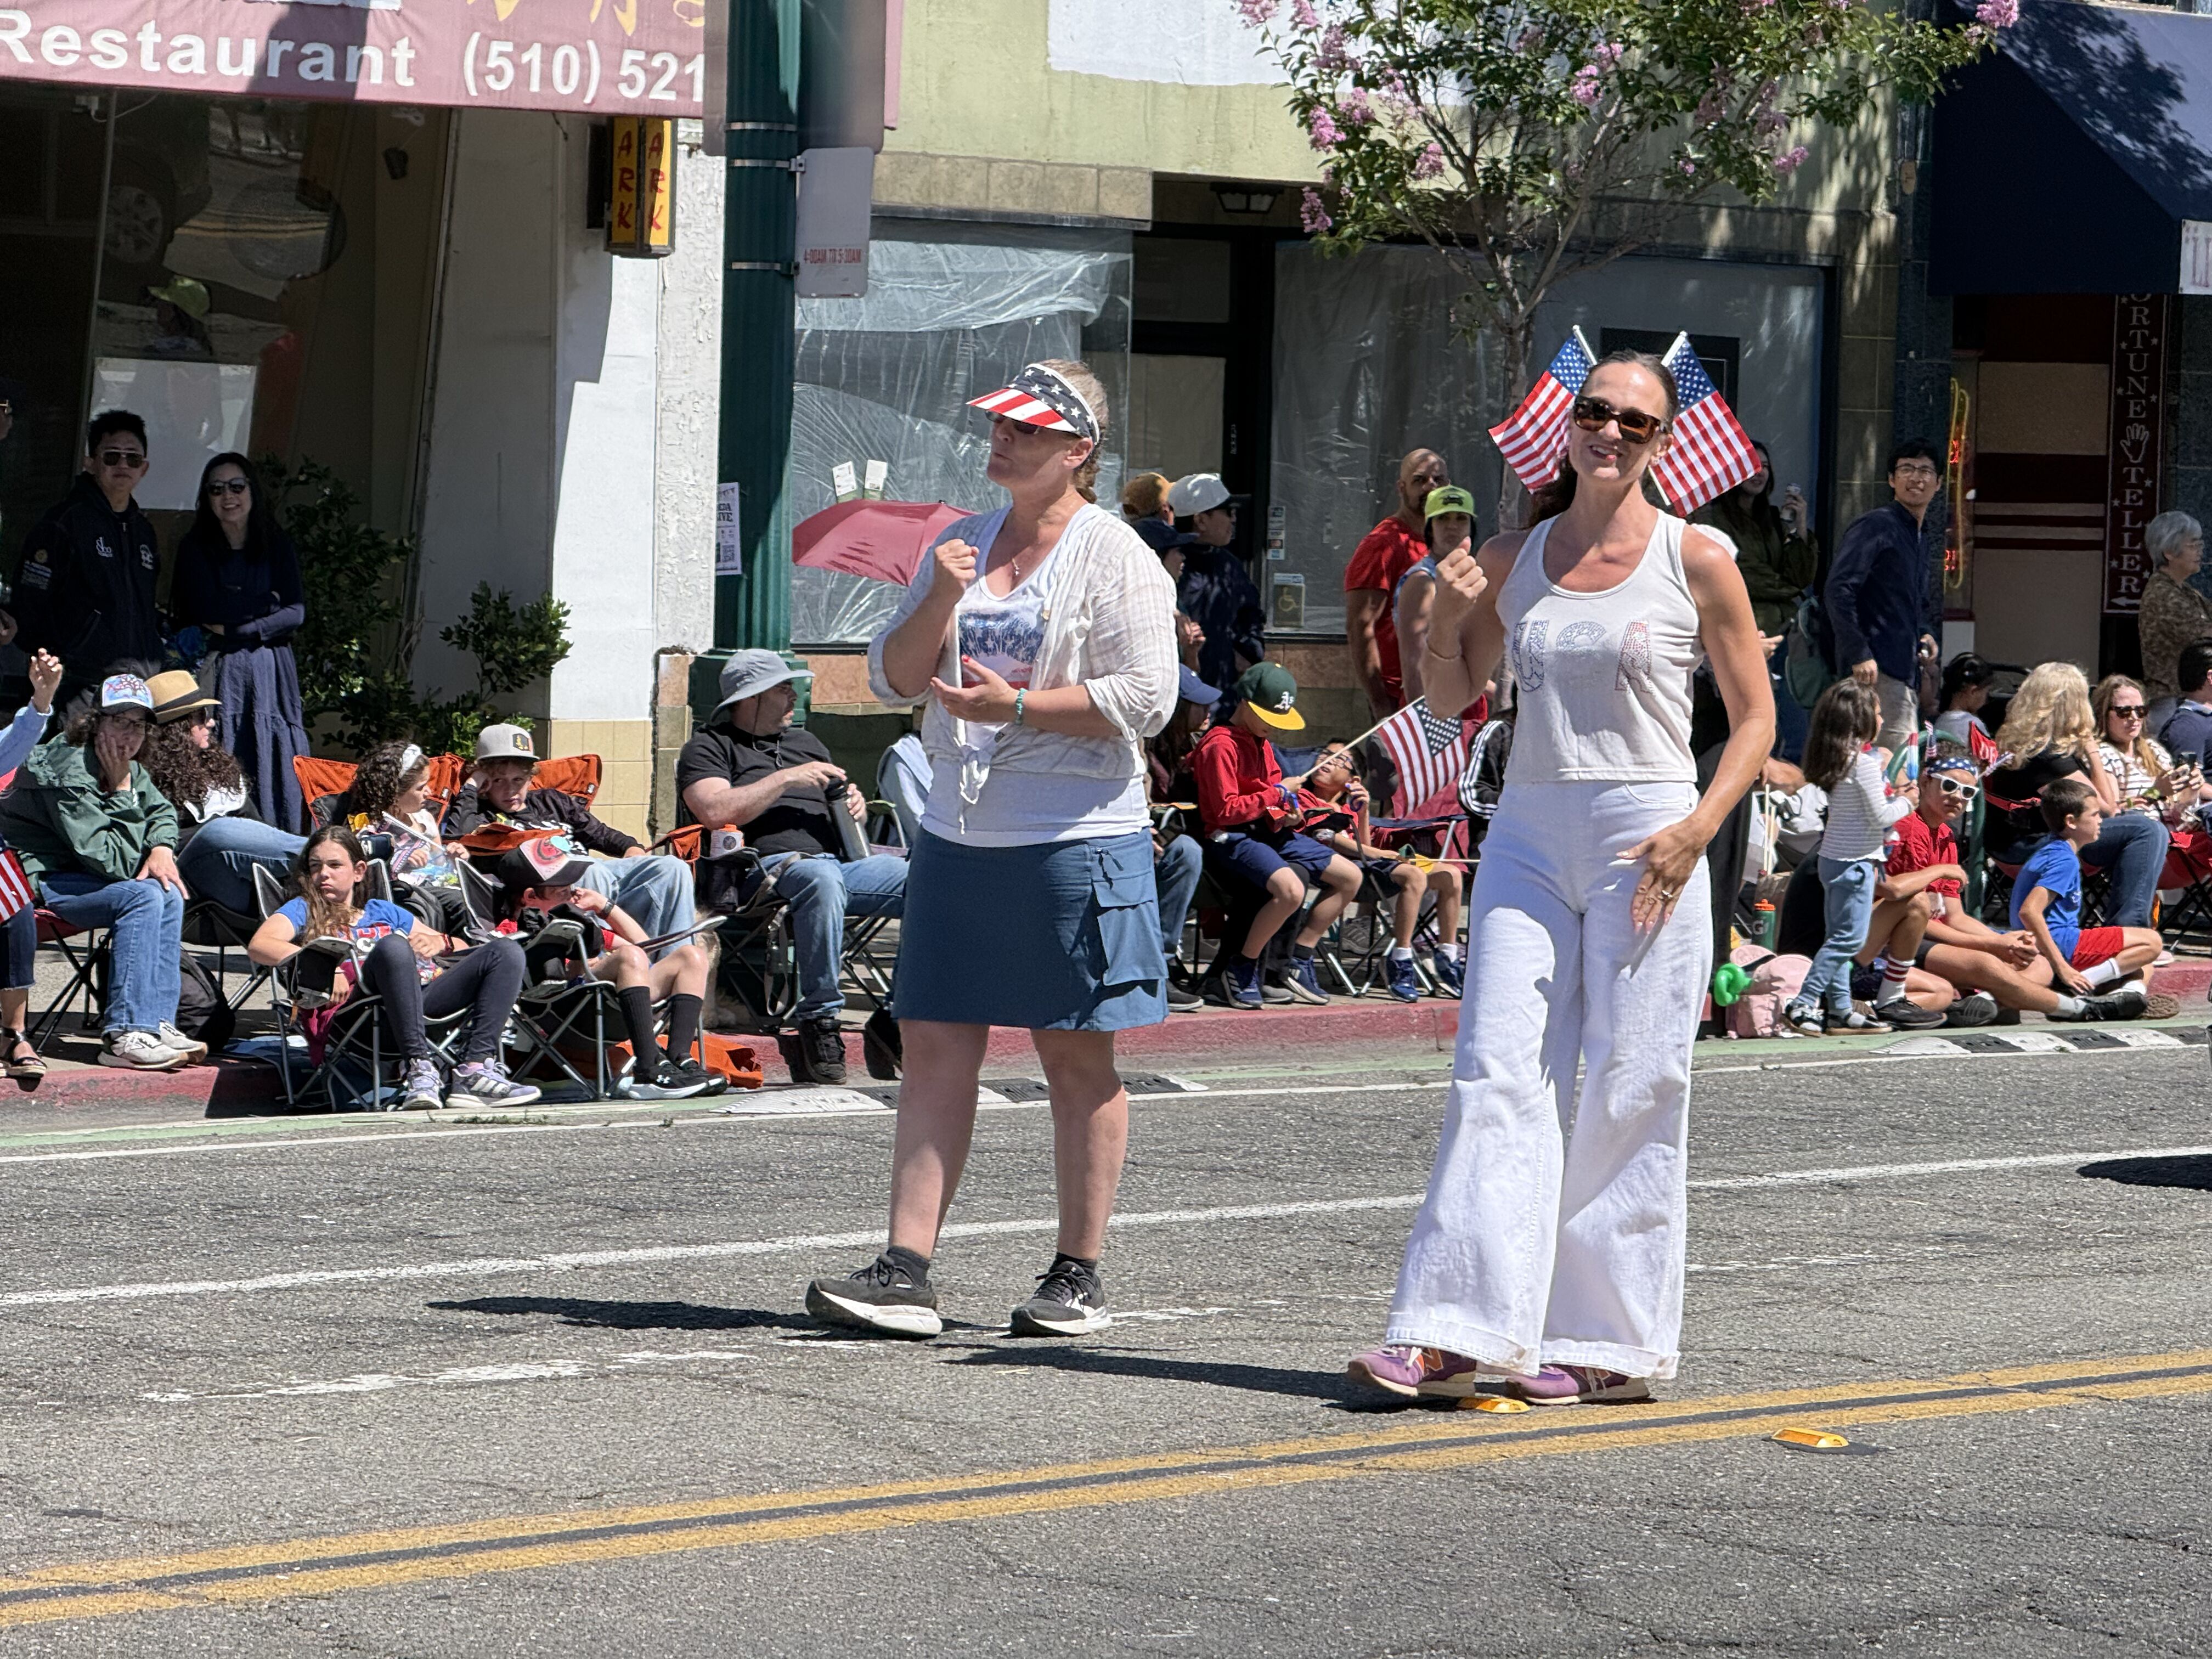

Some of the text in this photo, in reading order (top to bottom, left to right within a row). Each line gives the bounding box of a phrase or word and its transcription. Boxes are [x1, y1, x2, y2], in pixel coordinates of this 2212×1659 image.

[0, 9, 416, 86] Restaurant
[464, 31, 601, 104] (510)
[617, 131, 634, 230] ARK
[648, 132, 665, 230] ARK
[829, 249, 836, 263] TO
[2116, 467, 2145, 594] TELLER
